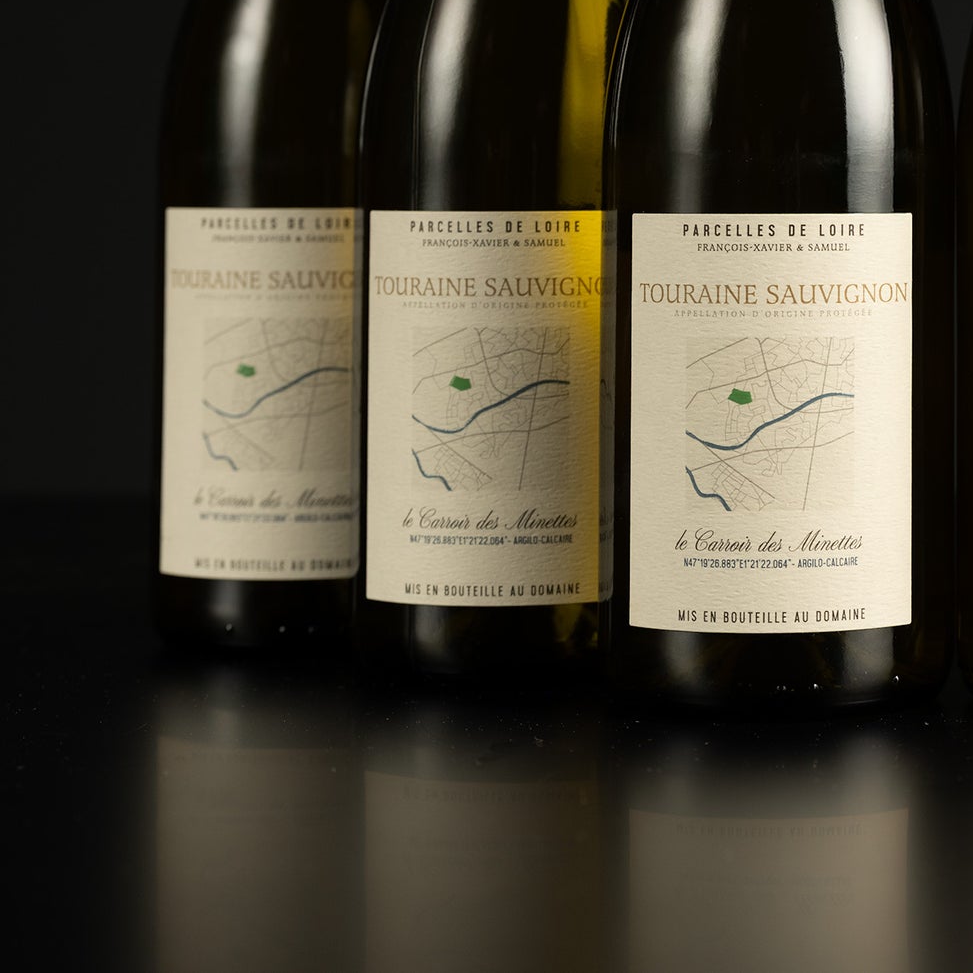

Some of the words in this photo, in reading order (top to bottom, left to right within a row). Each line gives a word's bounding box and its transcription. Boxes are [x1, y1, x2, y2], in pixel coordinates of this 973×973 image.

[315, 217, 351, 229] LOIR
[410, 221, 494, 232] PARCELLES
[506, 221, 523, 232] DE
[535, 221, 580, 232] LOIRE
[683, 224, 776, 237] PARCELLES
[789, 224, 806, 237] DE
[819, 223, 864, 236] LOIRE
[422, 239, 509, 248] FRANÇOIS-XAVIER
[524, 239, 565, 247] SAMUEL
[697, 243, 792, 253] FRANÇOIS-XAVIER
[808, 243, 850, 251] SAMUEL
[268, 270, 354, 290] SAUVIG
[375, 276, 477, 297] TOURAINE
[484, 277, 601, 297] SAUVIGN
[640, 283, 757, 304] TOURAINE
[766, 283, 908, 304] SAUVIGNON
[674, 309, 745, 317] APPELLATION
[752, 309, 813, 317] D'ORIGINE
[820, 308, 872, 317] PROTÉGÉE
[402, 508, 413, 527] le
[419, 506, 470, 529] Carroir
[476, 510, 498, 529] des
[504, 508, 577, 530] Minettes
[675, 529, 687, 550] le
[694, 527, 752, 552] Carroir
[758, 531, 782, 552] des
[788, 529, 862, 552] Minettes
[798, 557, 858, 568] ARGILO-CALCAIRE
[405, 583, 421, 594] MIS
[427, 584, 438, 595] EN
[444, 585, 503, 597] BOUTEILLE
[510, 586, 524, 596] AU
[531, 583, 580, 595] DOMAINE
[678, 609, 696, 621] MIS
[704, 611, 716, 622] EN
[724, 611, 787, 623] BOUTEILLE
[794, 611, 809, 622] AU
[816, 608, 866, 622] DOMAINE
